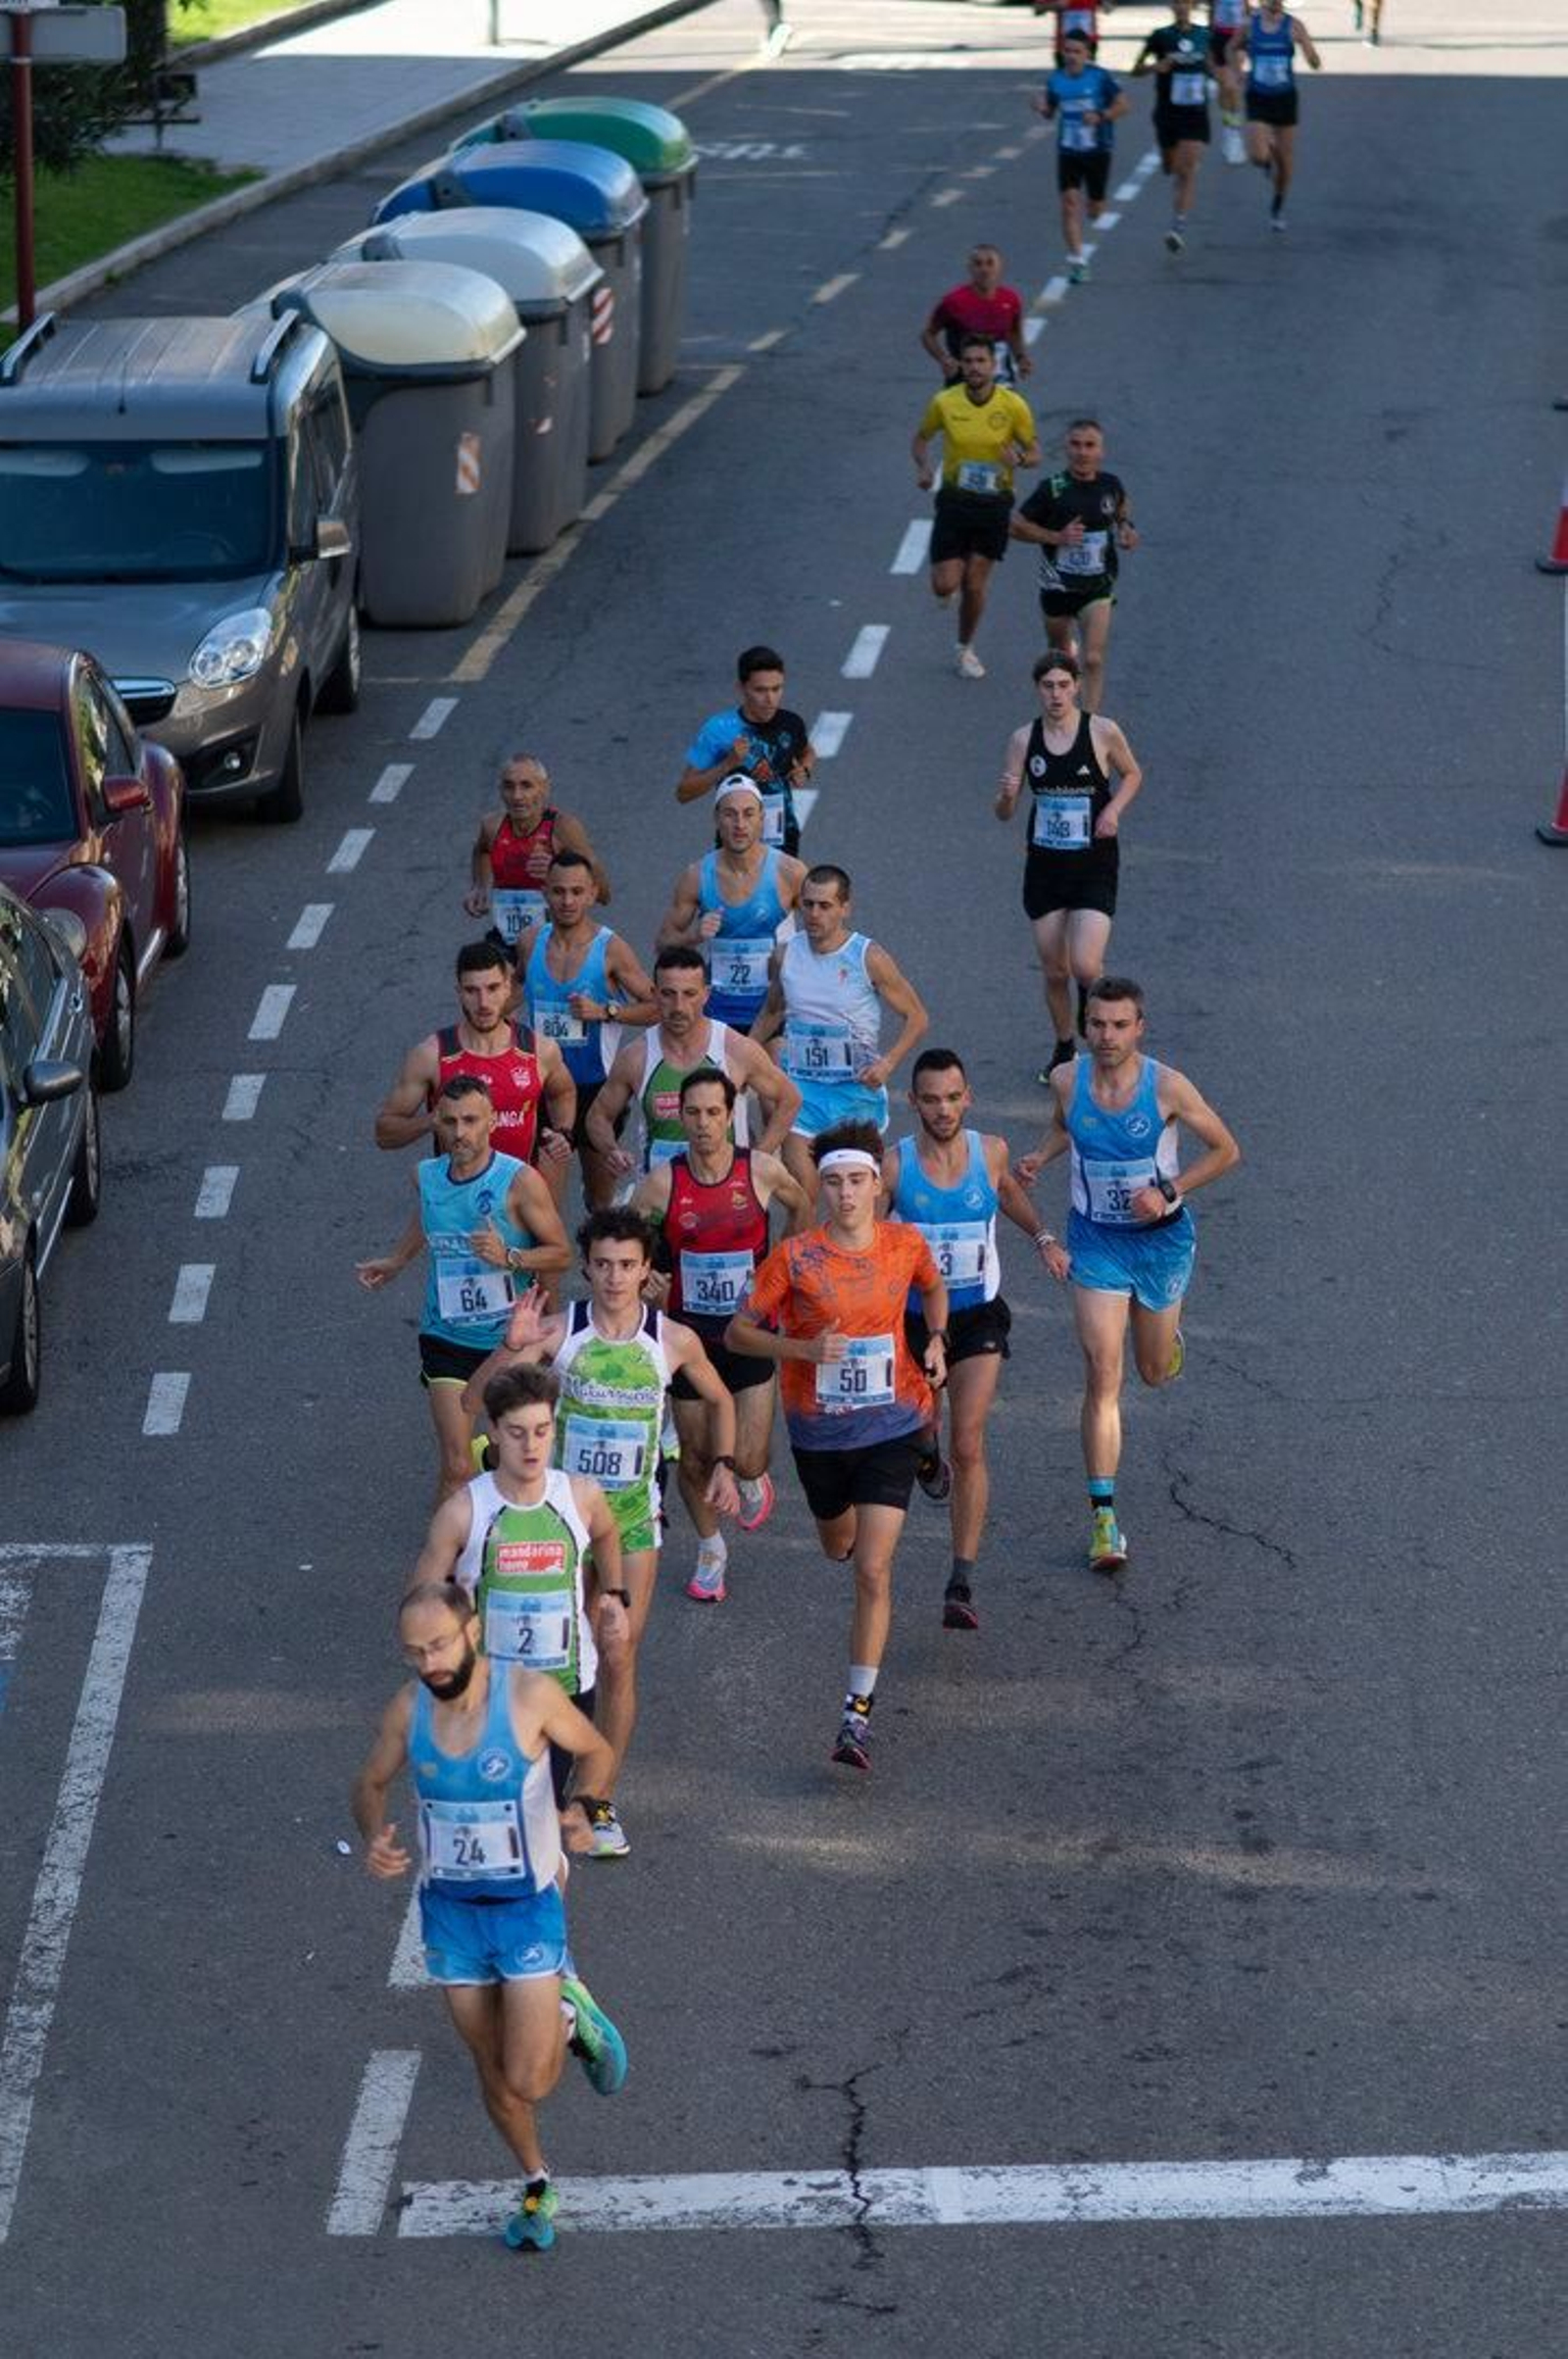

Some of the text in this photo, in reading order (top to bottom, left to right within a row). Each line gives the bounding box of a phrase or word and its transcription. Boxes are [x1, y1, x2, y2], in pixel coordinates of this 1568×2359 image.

[730, 963, 751, 985] 22
[806, 1047, 828, 1066] 151
[461, 1287, 488, 1312] 64
[696, 1280, 735, 1303] 340
[840, 1368, 867, 1393] 50
[577, 1449, 622, 1476] 508
[517, 1628, 533, 1654] 2
[453, 1838, 487, 1866] 24
